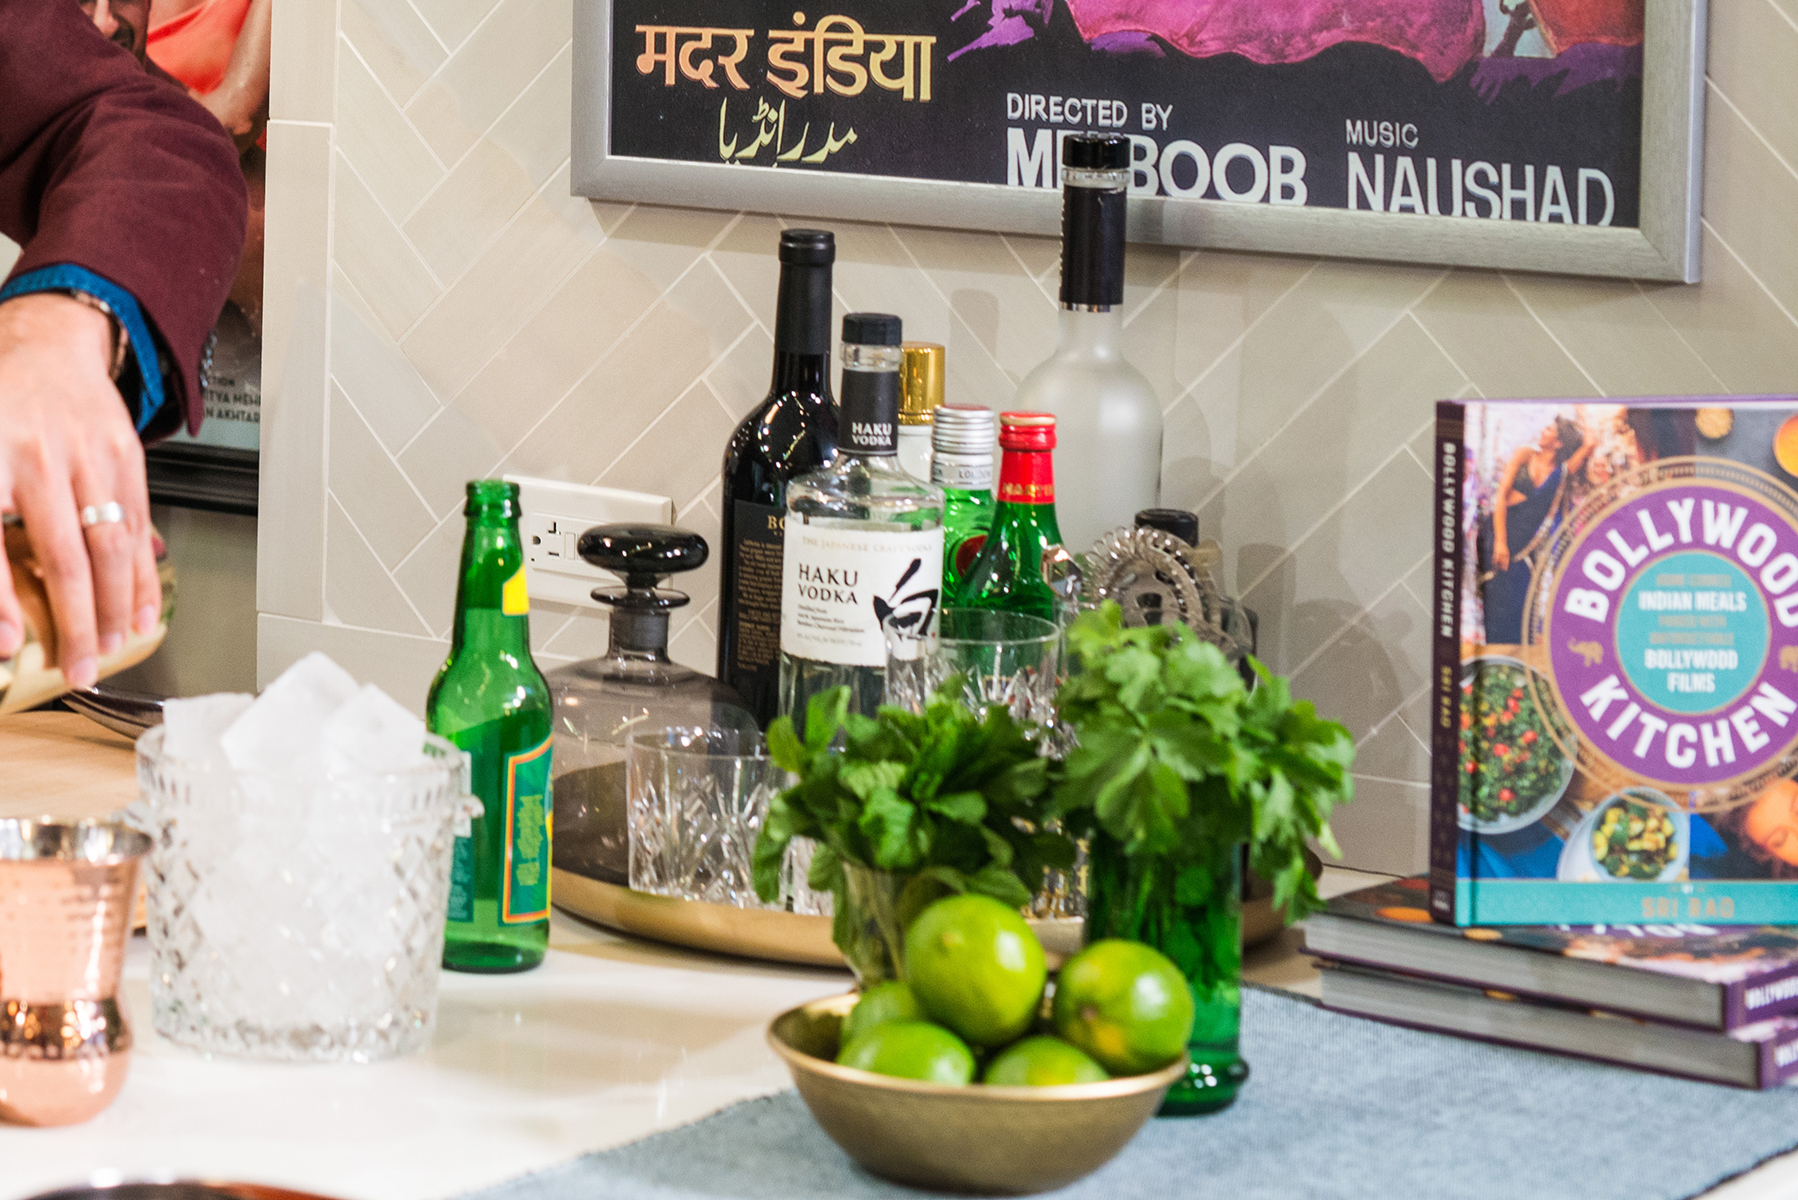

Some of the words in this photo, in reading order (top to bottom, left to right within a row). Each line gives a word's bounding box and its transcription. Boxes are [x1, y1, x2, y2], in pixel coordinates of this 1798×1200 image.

[635, 24, 755, 91] मदर
[766, 11, 937, 102] इंडिया
[1006, 91, 1129, 131] DIRECTED
[1140, 102, 1174, 132] BY
[1346, 119, 1420, 148] MUSIC
[1005, 126, 1309, 207] MBOOB
[1347, 151, 1616, 228] NAUSHAD
[852, 422, 893, 437] HAKU
[852, 434, 893, 447] VODKA
[1441, 442, 1456, 552] BOLLYWOOD
[798, 563, 858, 587] HAKU
[1564, 496, 1798, 628] BOLLYWOOD
[797, 583, 859, 605] VODKA
[1440, 556, 1455, 638] KITCHEN
[1638, 590, 1693, 611] INDIAN
[1694, 590, 1747, 612] MEALS
[1644, 648, 1738, 670] BOLLYWOOD
[1666, 672, 1716, 693] FILMS
[1580, 674, 1798, 768] KITCHEN
